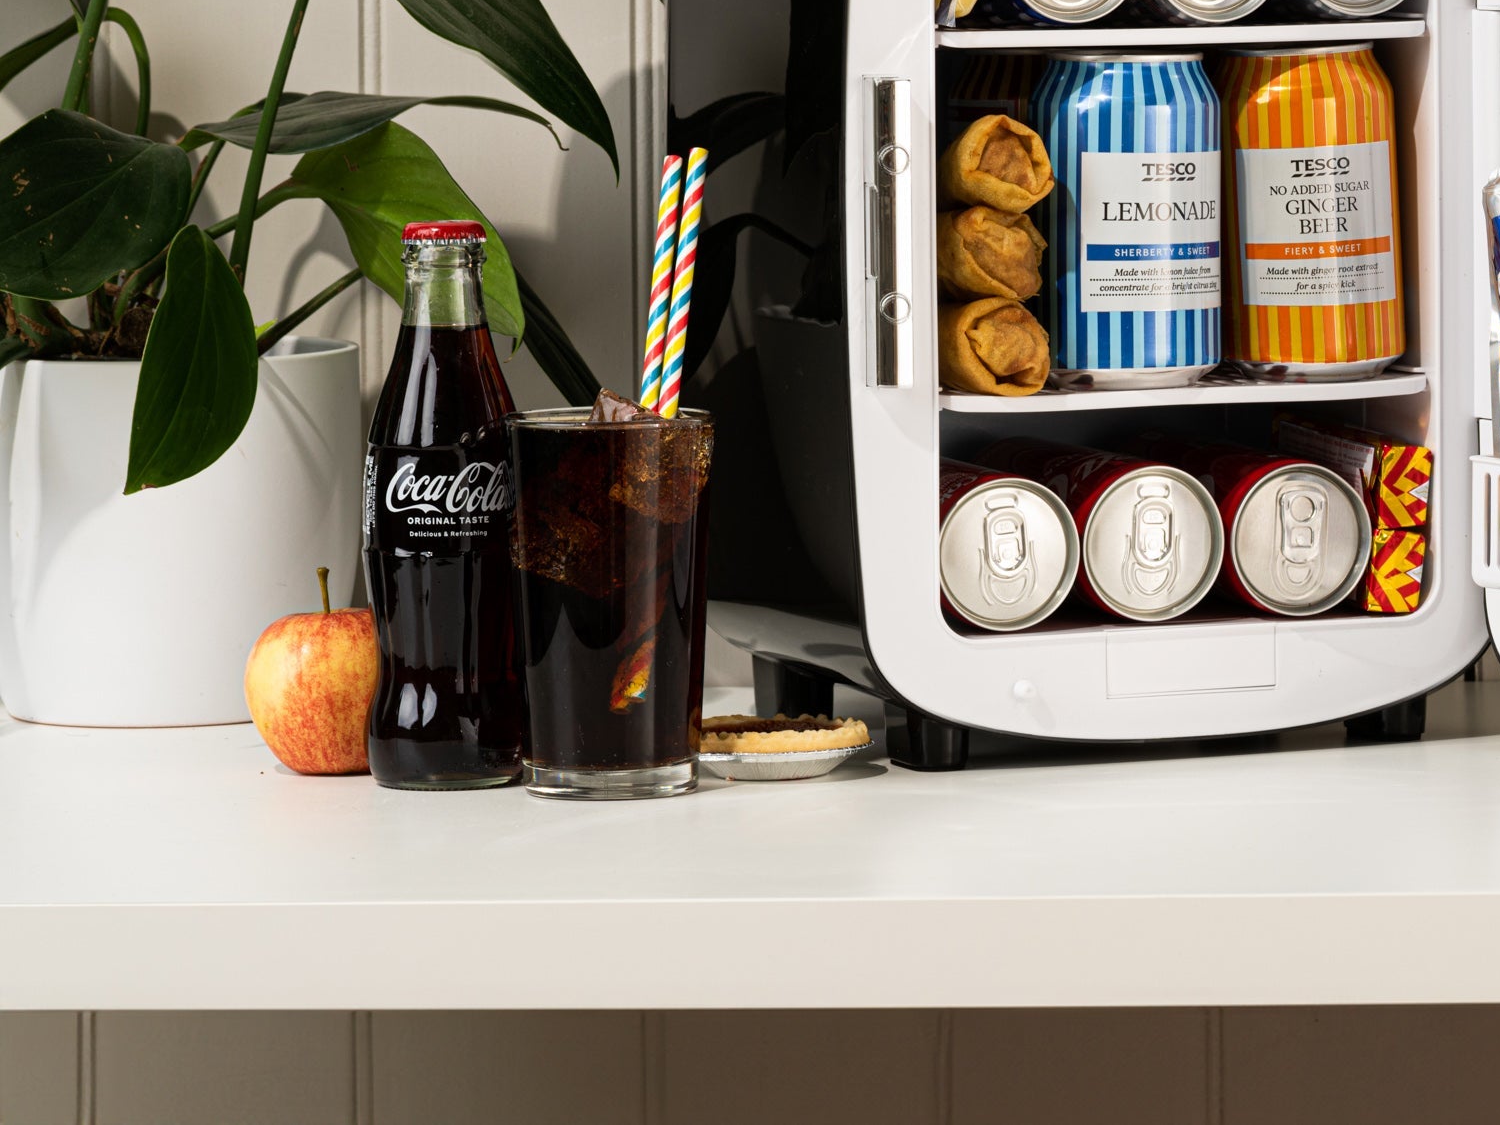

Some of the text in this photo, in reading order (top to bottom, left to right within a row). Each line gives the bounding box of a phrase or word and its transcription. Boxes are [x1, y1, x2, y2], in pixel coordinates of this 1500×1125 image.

[1142, 163, 1197, 176] TESCO
[1290, 156, 1350, 172] TESCO
[1270, 180, 1370, 196] NO ADDED SUGAR
[1102, 200, 1216, 221] LEMONADE
[1285, 196, 1359, 216] GINGER
[1299, 216, 1348, 235] BEER
[1114, 245, 1211, 258] SHERBERTY & SWEET
[1284, 243, 1362, 256] FIERY & SWEET
[1114, 267, 1139, 277] Made
[1140, 267, 1159, 276] with
[1266, 266, 1289, 276] Made
[1291, 266, 1309, 275] with
[1338, 264, 1354, 274] root
[1099, 282, 1149, 293] concentrate
[1295, 281, 1309, 292] for
[1311, 282, 1317, 290] a
[1341, 279, 1356, 289] kick
[385, 461, 508, 514] Coca-Cola
[407, 515, 490, 526] ORIGINAL TASTE
[409, 530, 442, 538] Delicious
[451, 530, 488, 539] Refreshing
